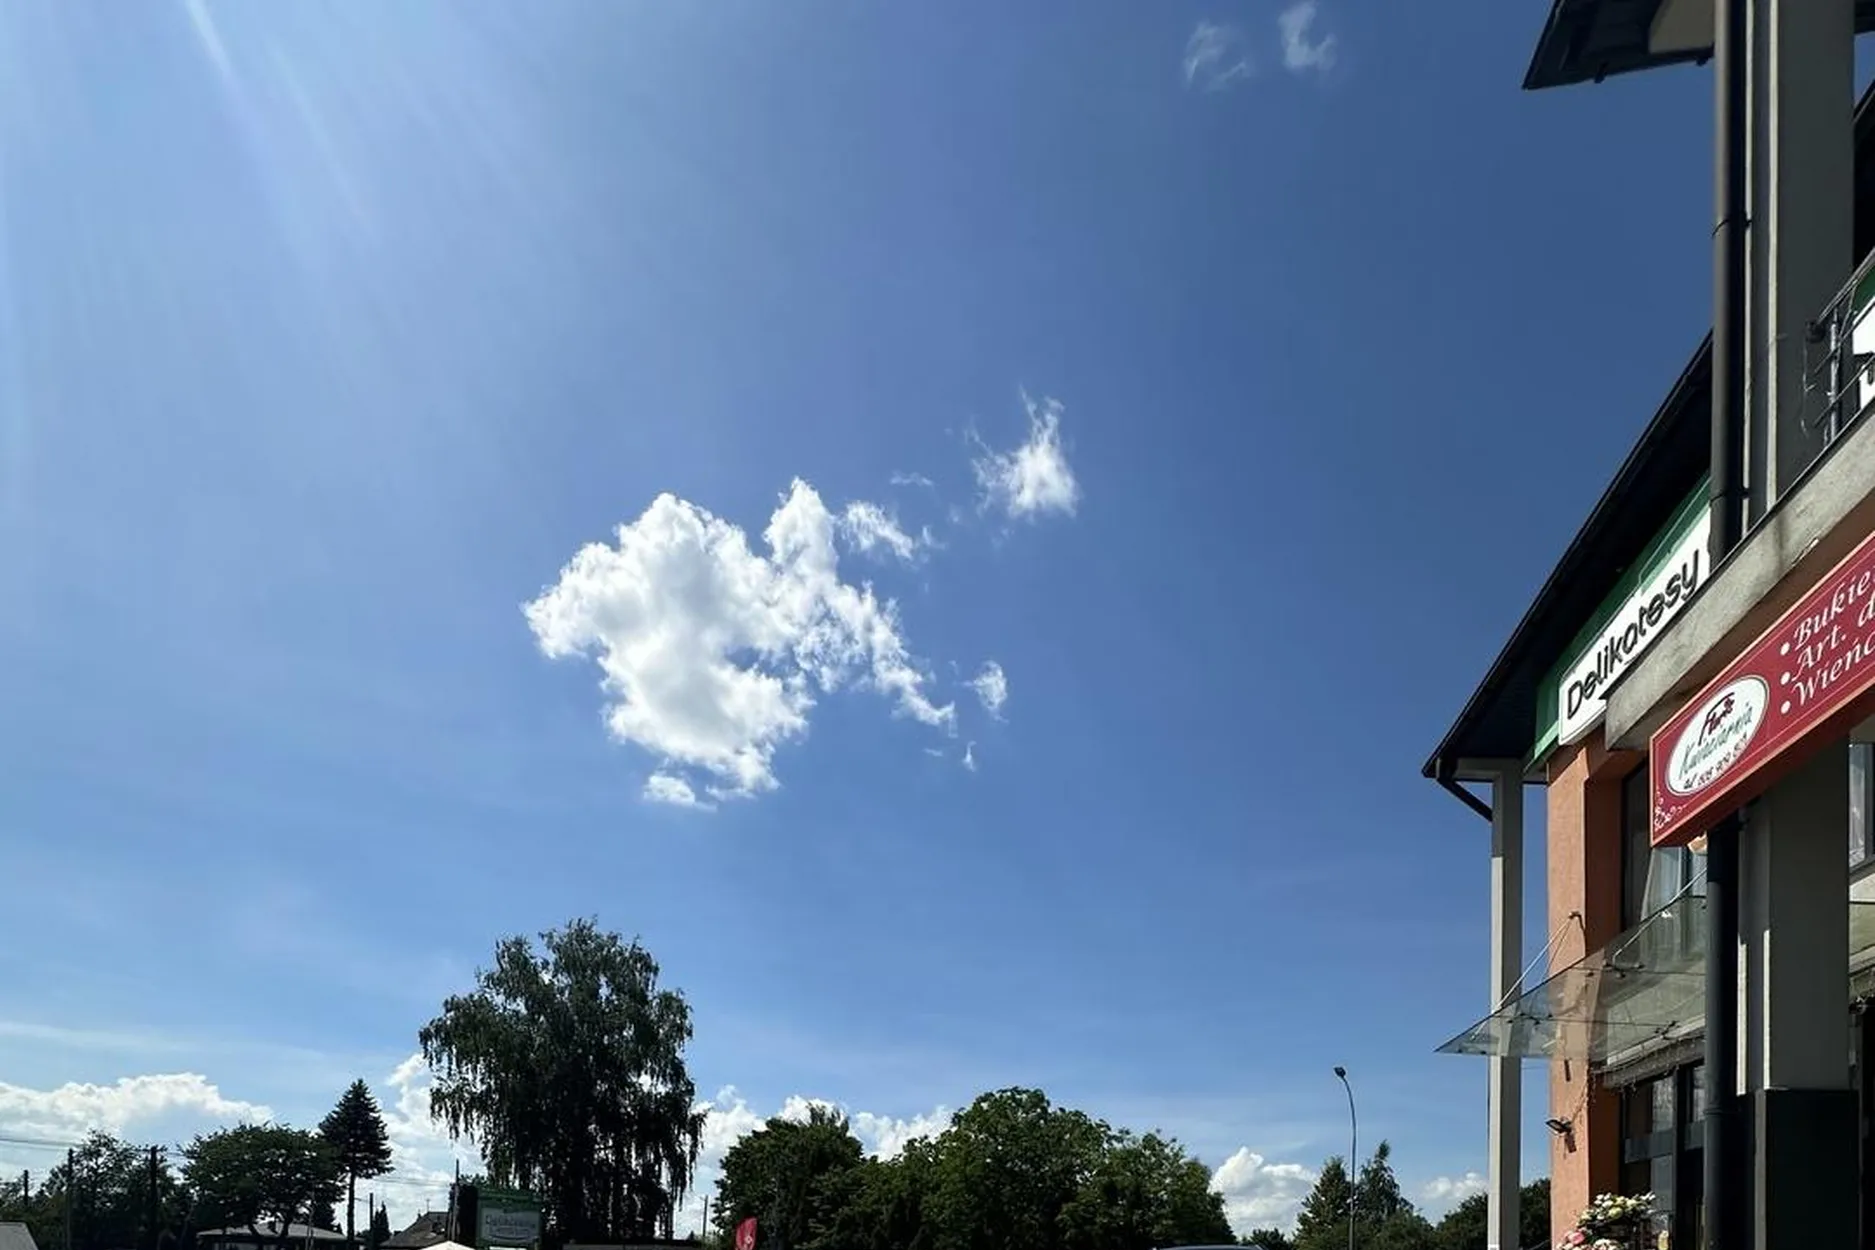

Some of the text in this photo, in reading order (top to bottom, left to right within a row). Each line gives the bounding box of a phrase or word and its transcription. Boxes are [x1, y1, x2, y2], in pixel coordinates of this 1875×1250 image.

[1568, 549, 1698, 719] Delikatesy
[1794, 566, 1875, 650] Bukie
[1791, 625, 1846, 682] Art.
